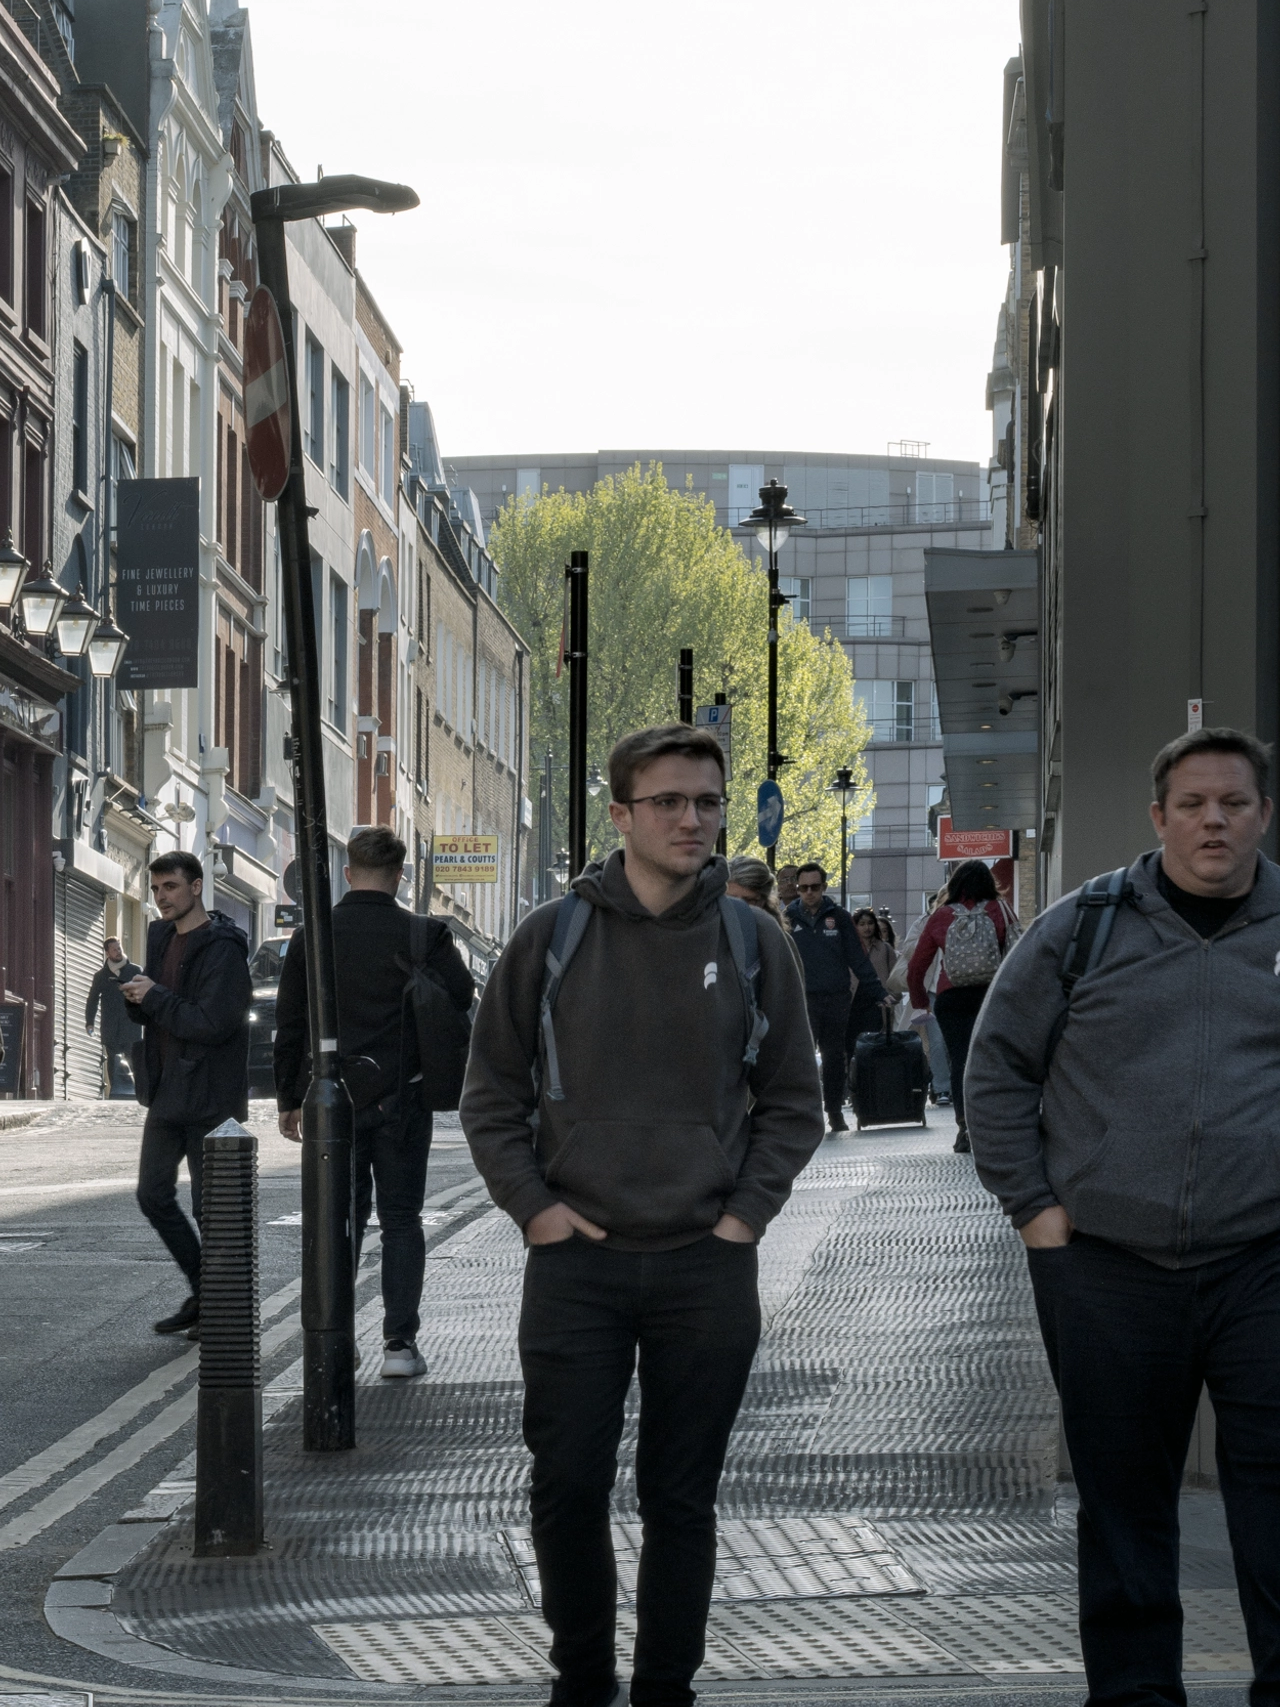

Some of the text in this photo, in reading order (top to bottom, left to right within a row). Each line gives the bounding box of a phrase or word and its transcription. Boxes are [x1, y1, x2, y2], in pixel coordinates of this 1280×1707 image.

[122, 567, 194, 580] FINE JEWELLERY
[146, 584, 179, 596] LUXURY
[131, 599, 185, 612] TIME PIECES
[944, 833, 1006, 843] SANDWICHES
[440, 843, 491, 853] TO LET
[956, 843, 994, 855] SALADS
[434, 855, 496, 863] PEARL & COUTTS
